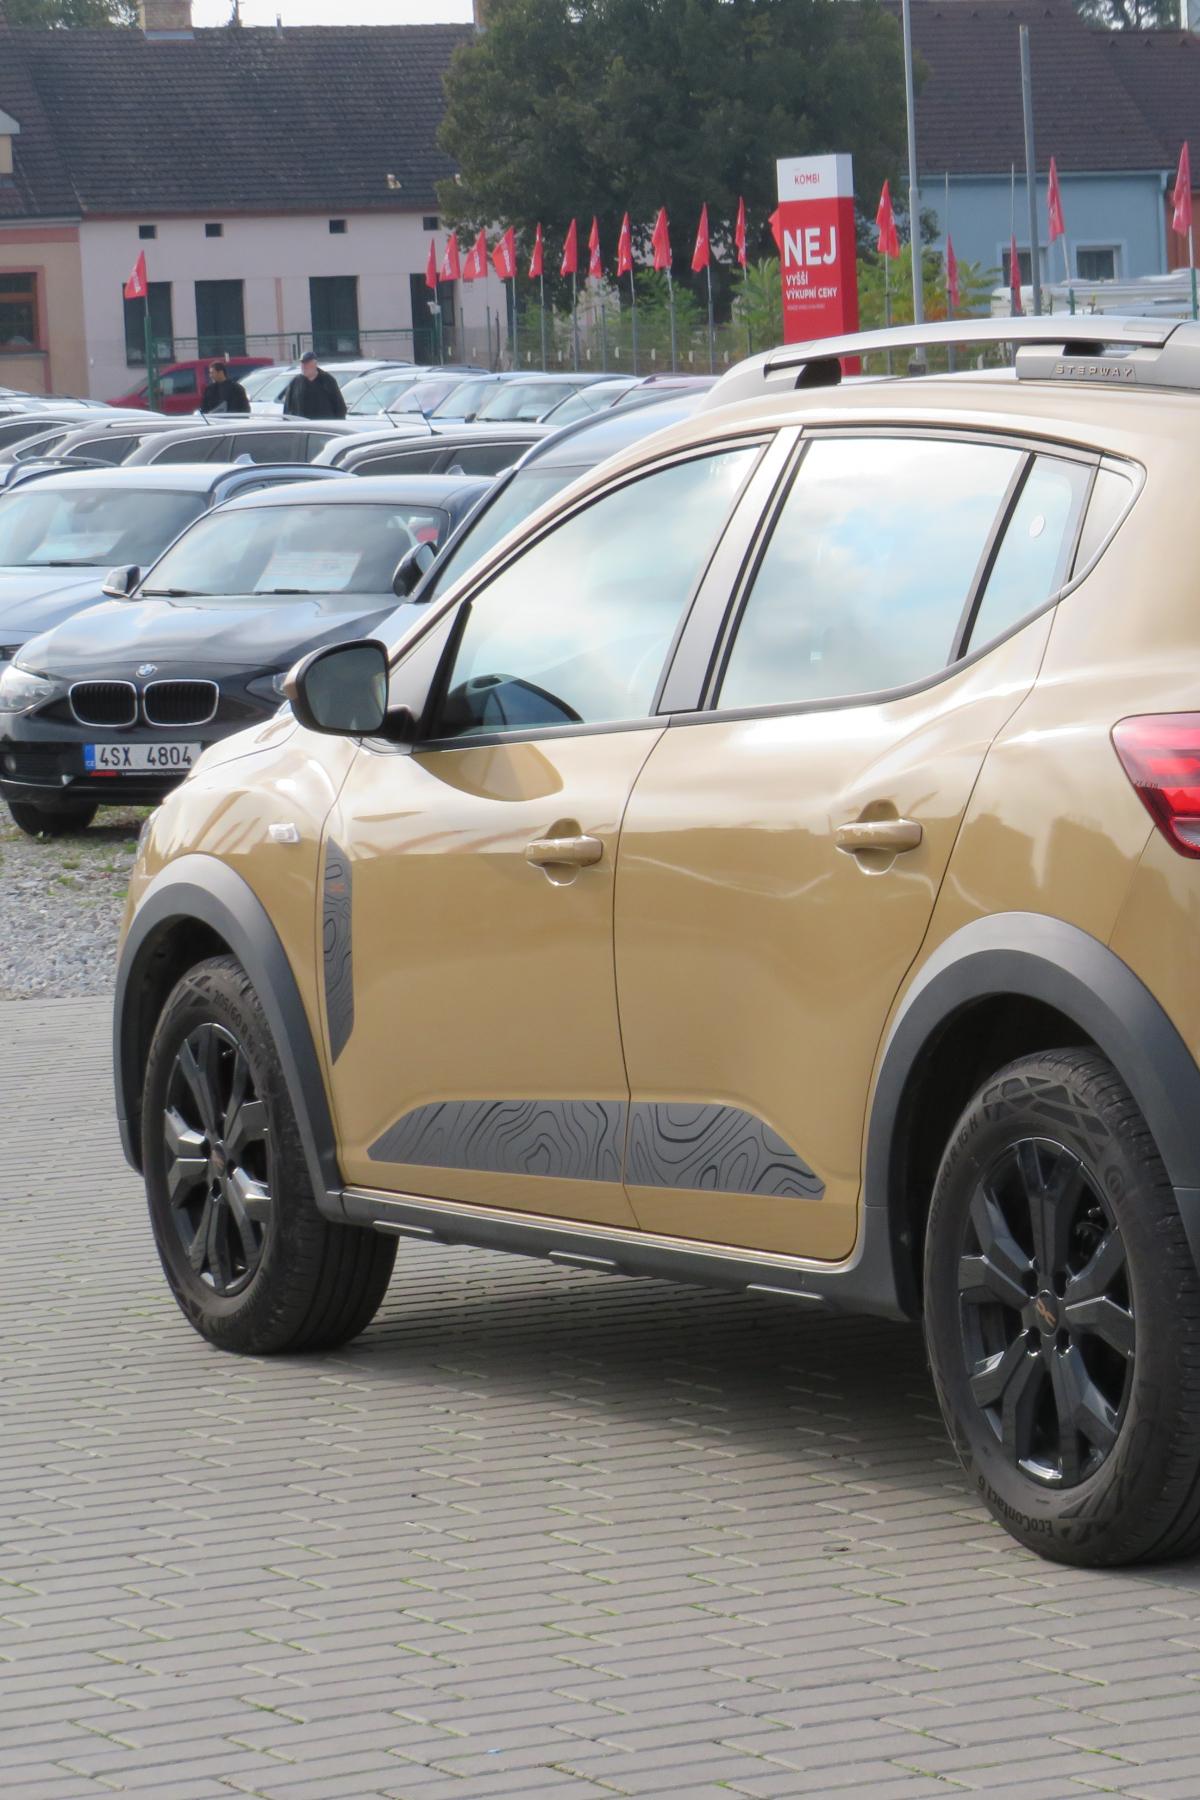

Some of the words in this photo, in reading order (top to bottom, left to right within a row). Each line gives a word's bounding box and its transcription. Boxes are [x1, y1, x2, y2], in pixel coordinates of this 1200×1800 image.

[794, 173, 820, 185] KOMBI
[783, 226, 837, 268] NEJ
[786, 271, 808, 286] VYŠŠÍ
[818, 287, 838, 299] CENY
[1056, 364, 1133, 377] STEPWAY
[100, 746, 132, 767] 4SX
[147, 746, 192, 766] 4804
